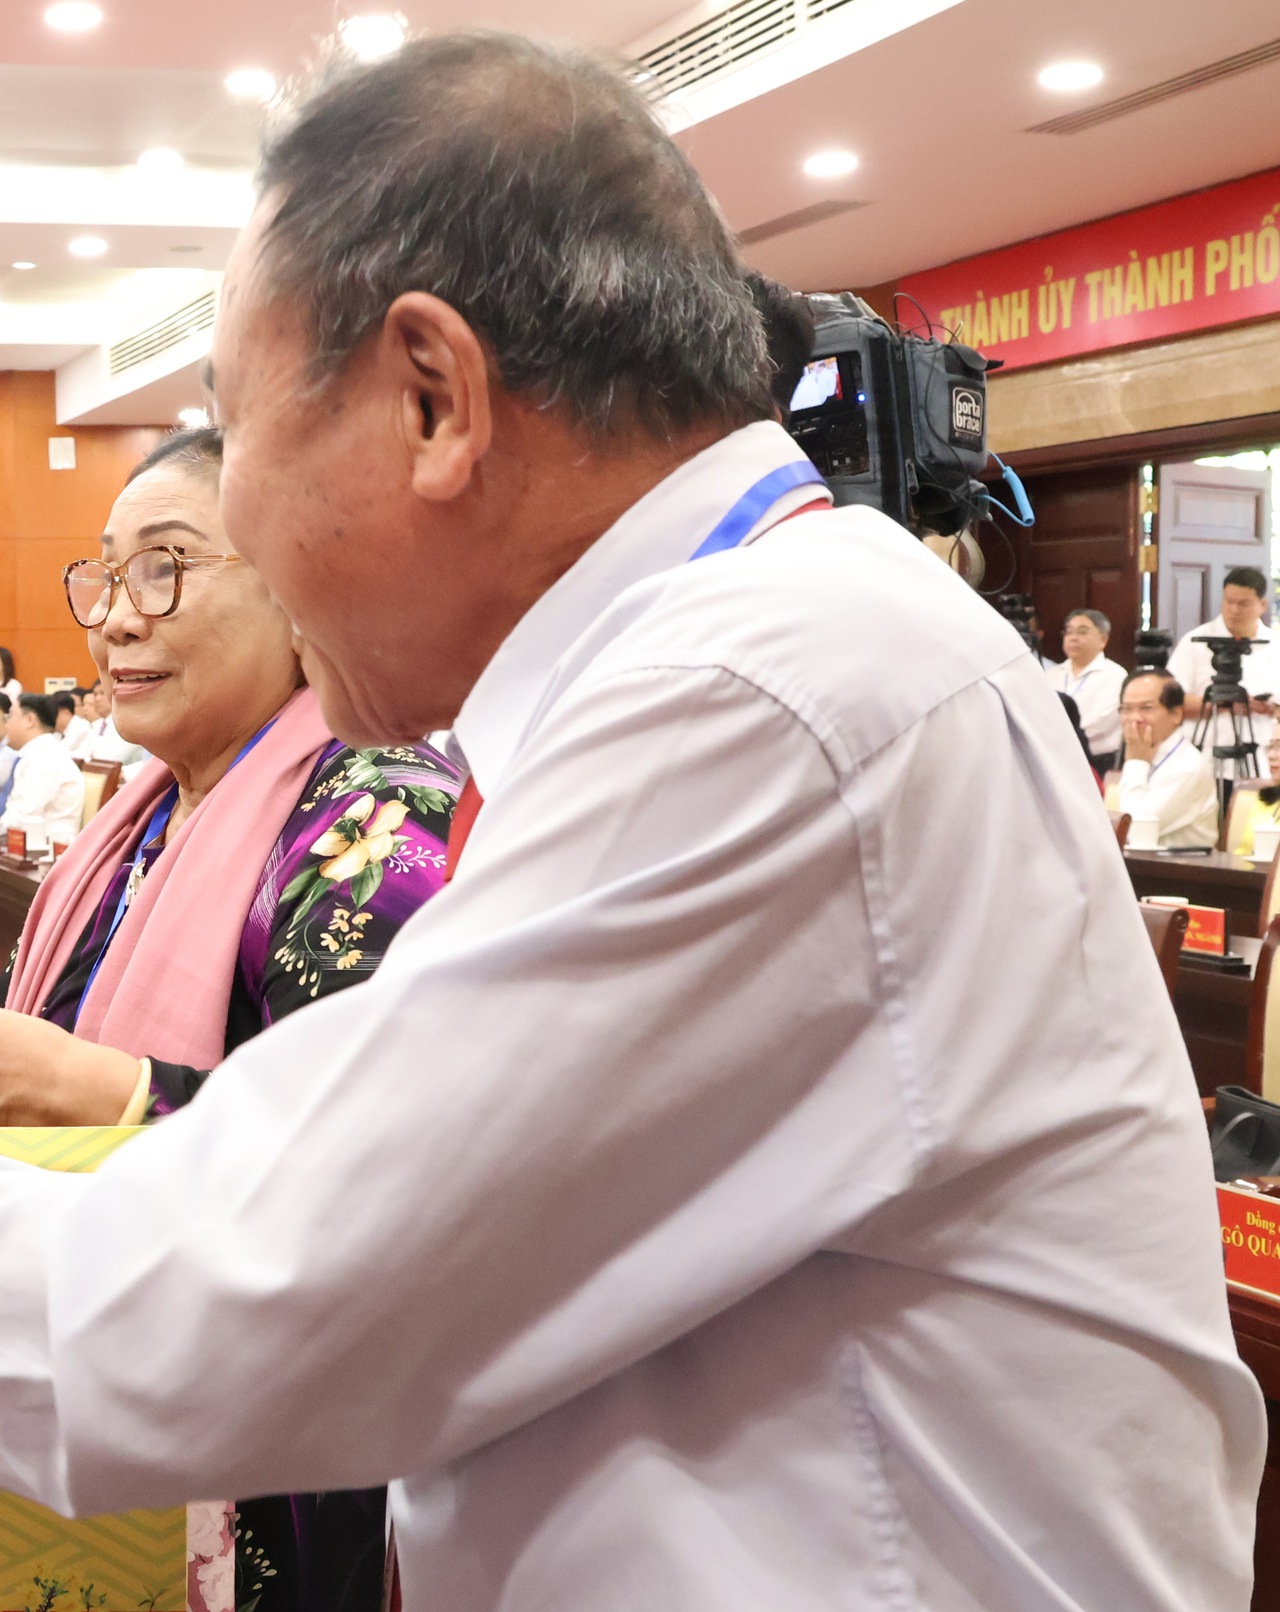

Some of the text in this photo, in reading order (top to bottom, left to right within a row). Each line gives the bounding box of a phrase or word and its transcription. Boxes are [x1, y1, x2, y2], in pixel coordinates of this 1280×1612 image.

[940, 203, 1280, 349] THÀNH ỦY THÀNH PHỐ
[1221, 1224, 1244, 1247] GÔ
